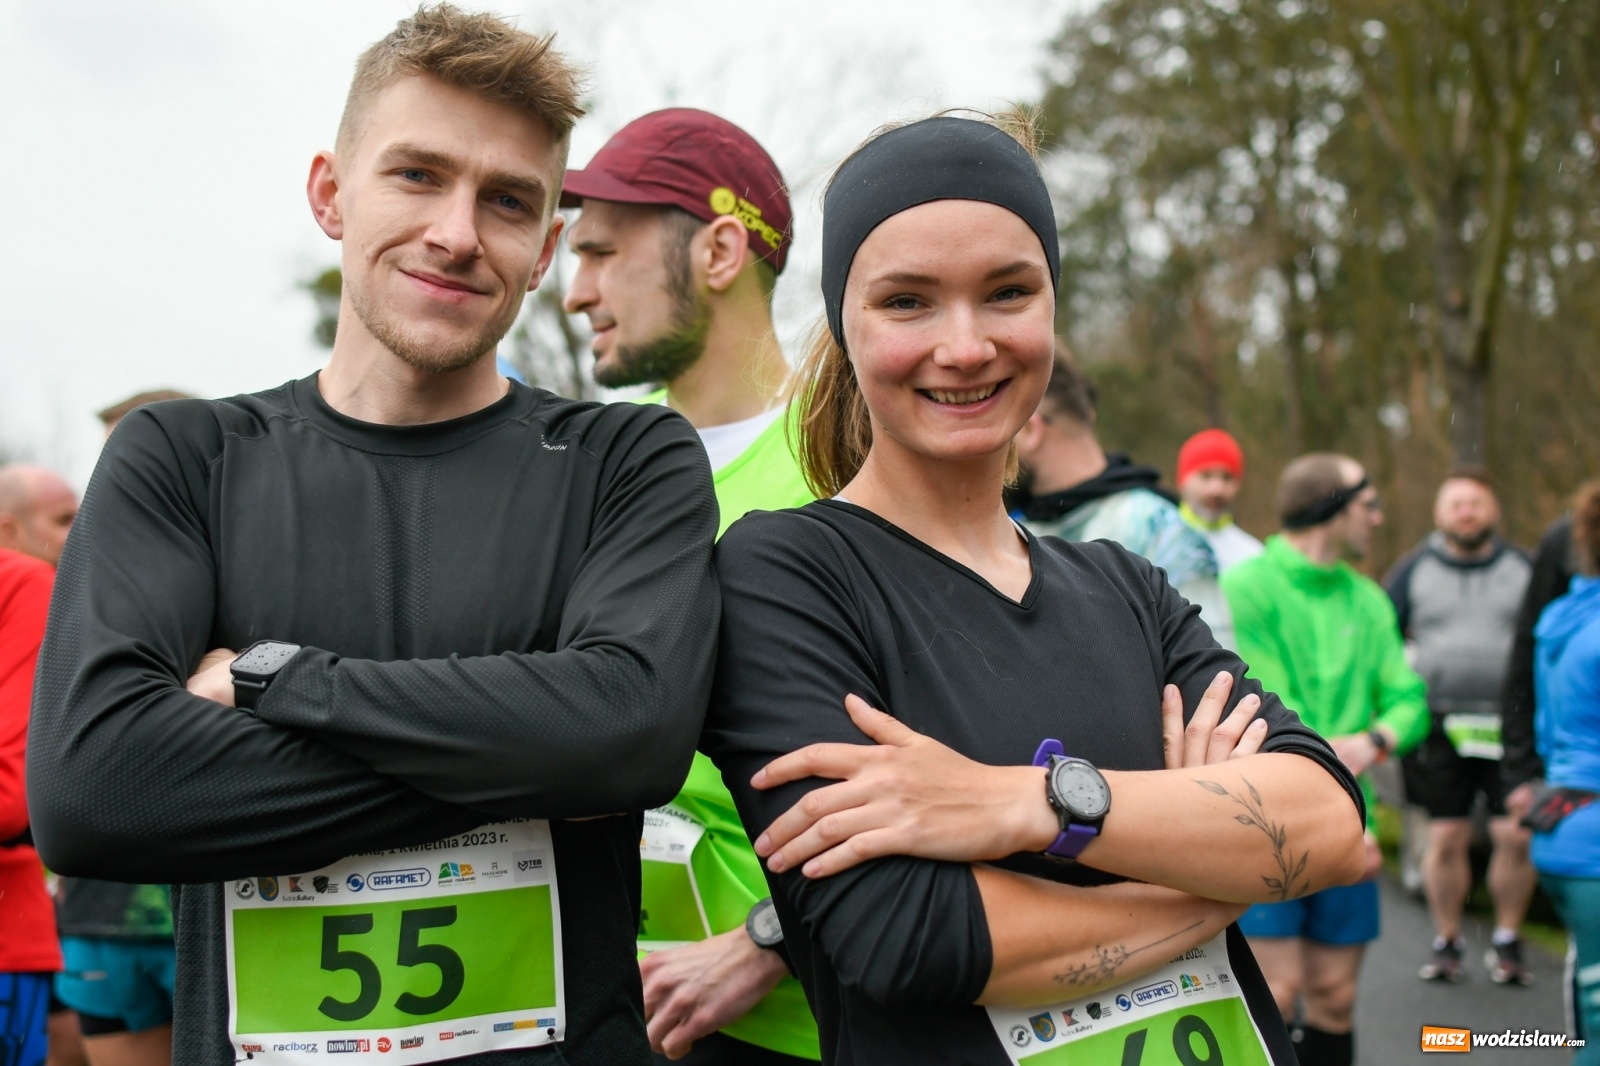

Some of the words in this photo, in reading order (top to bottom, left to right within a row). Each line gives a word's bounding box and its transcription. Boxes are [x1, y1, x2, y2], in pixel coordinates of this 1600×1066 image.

[461, 831, 497, 847] 2023
[500, 833, 509, 843] r.
[529, 858, 542, 866] TEB
[373, 871, 426, 887] RAFAMET
[317, 904, 466, 1022] 55
[1136, 983, 1175, 1003] RAFAMET
[273, 1042, 318, 1052] raciborz
[328, 1039, 369, 1053] nowiny.pl
[400, 1036, 424, 1046] nowiny
